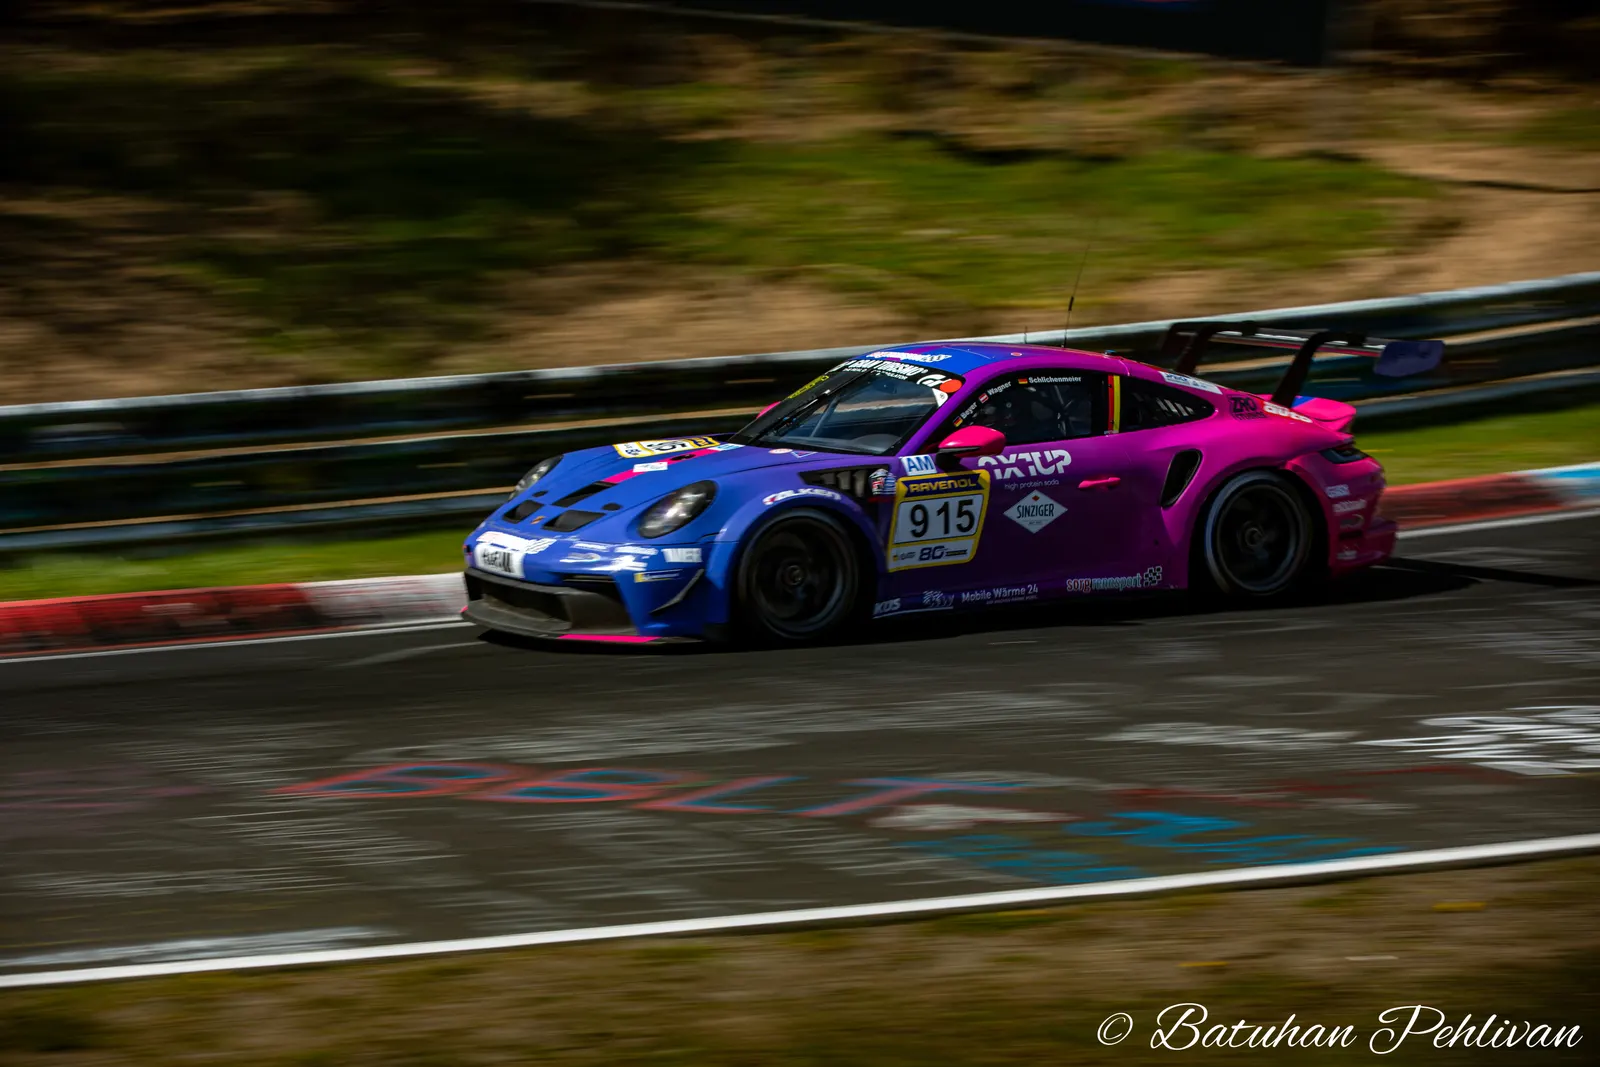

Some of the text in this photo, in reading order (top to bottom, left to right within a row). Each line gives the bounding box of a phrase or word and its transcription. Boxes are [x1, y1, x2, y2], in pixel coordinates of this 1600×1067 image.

[1028, 376, 1082, 384] Schlichenmeier
[987, 381, 1012, 396] Wagner
[906, 456, 935, 473] AM
[909, 478, 977, 493] RAVENOL
[1004, 482, 1019, 491] high
[1019, 481, 1043, 490] protein
[910, 499, 975, 538] 915
[1016, 503, 1055, 519] SINZIGER
[962, 588, 992, 603] Mobile
[992, 586, 1026, 599] Wärme
[1027, 583, 1039, 595] 24
